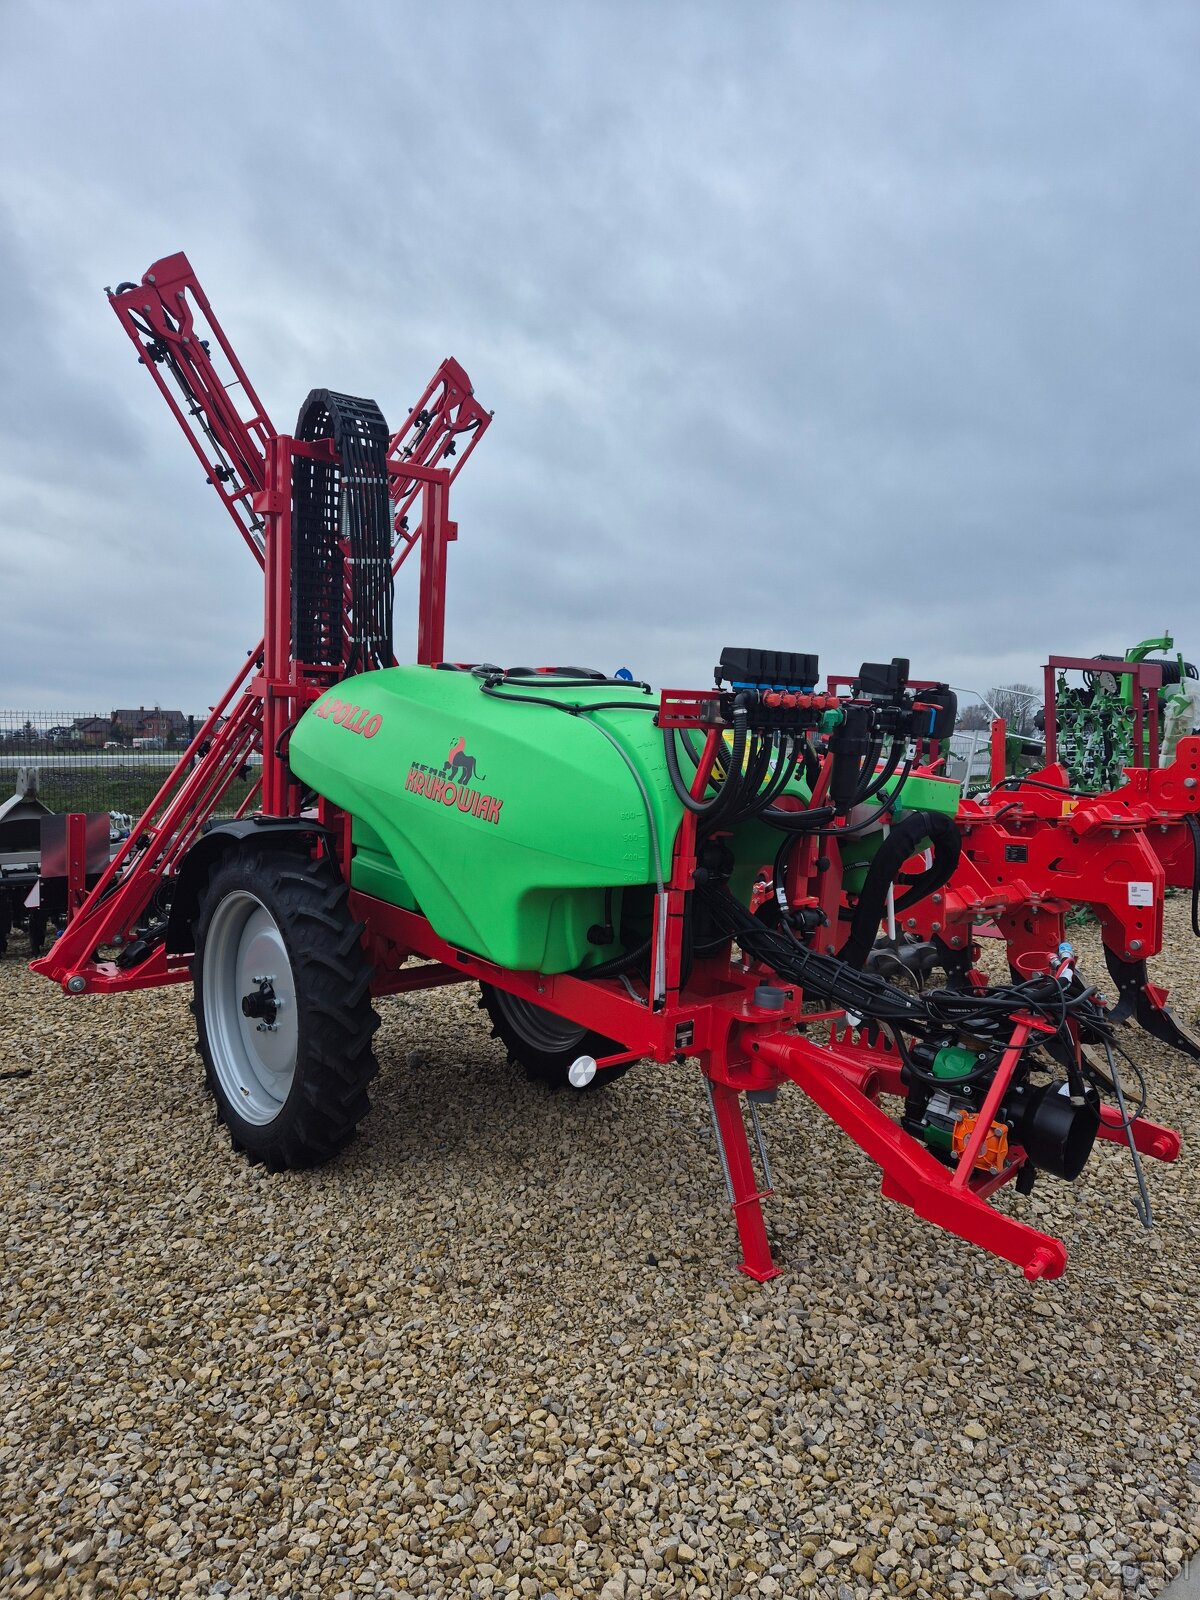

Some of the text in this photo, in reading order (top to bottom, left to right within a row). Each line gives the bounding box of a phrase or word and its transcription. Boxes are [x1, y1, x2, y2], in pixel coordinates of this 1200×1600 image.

[312, 696, 383, 739] APOLLO
[405, 768, 503, 825] KRUKOWIAK
[962, 783, 991, 794] RONAR
